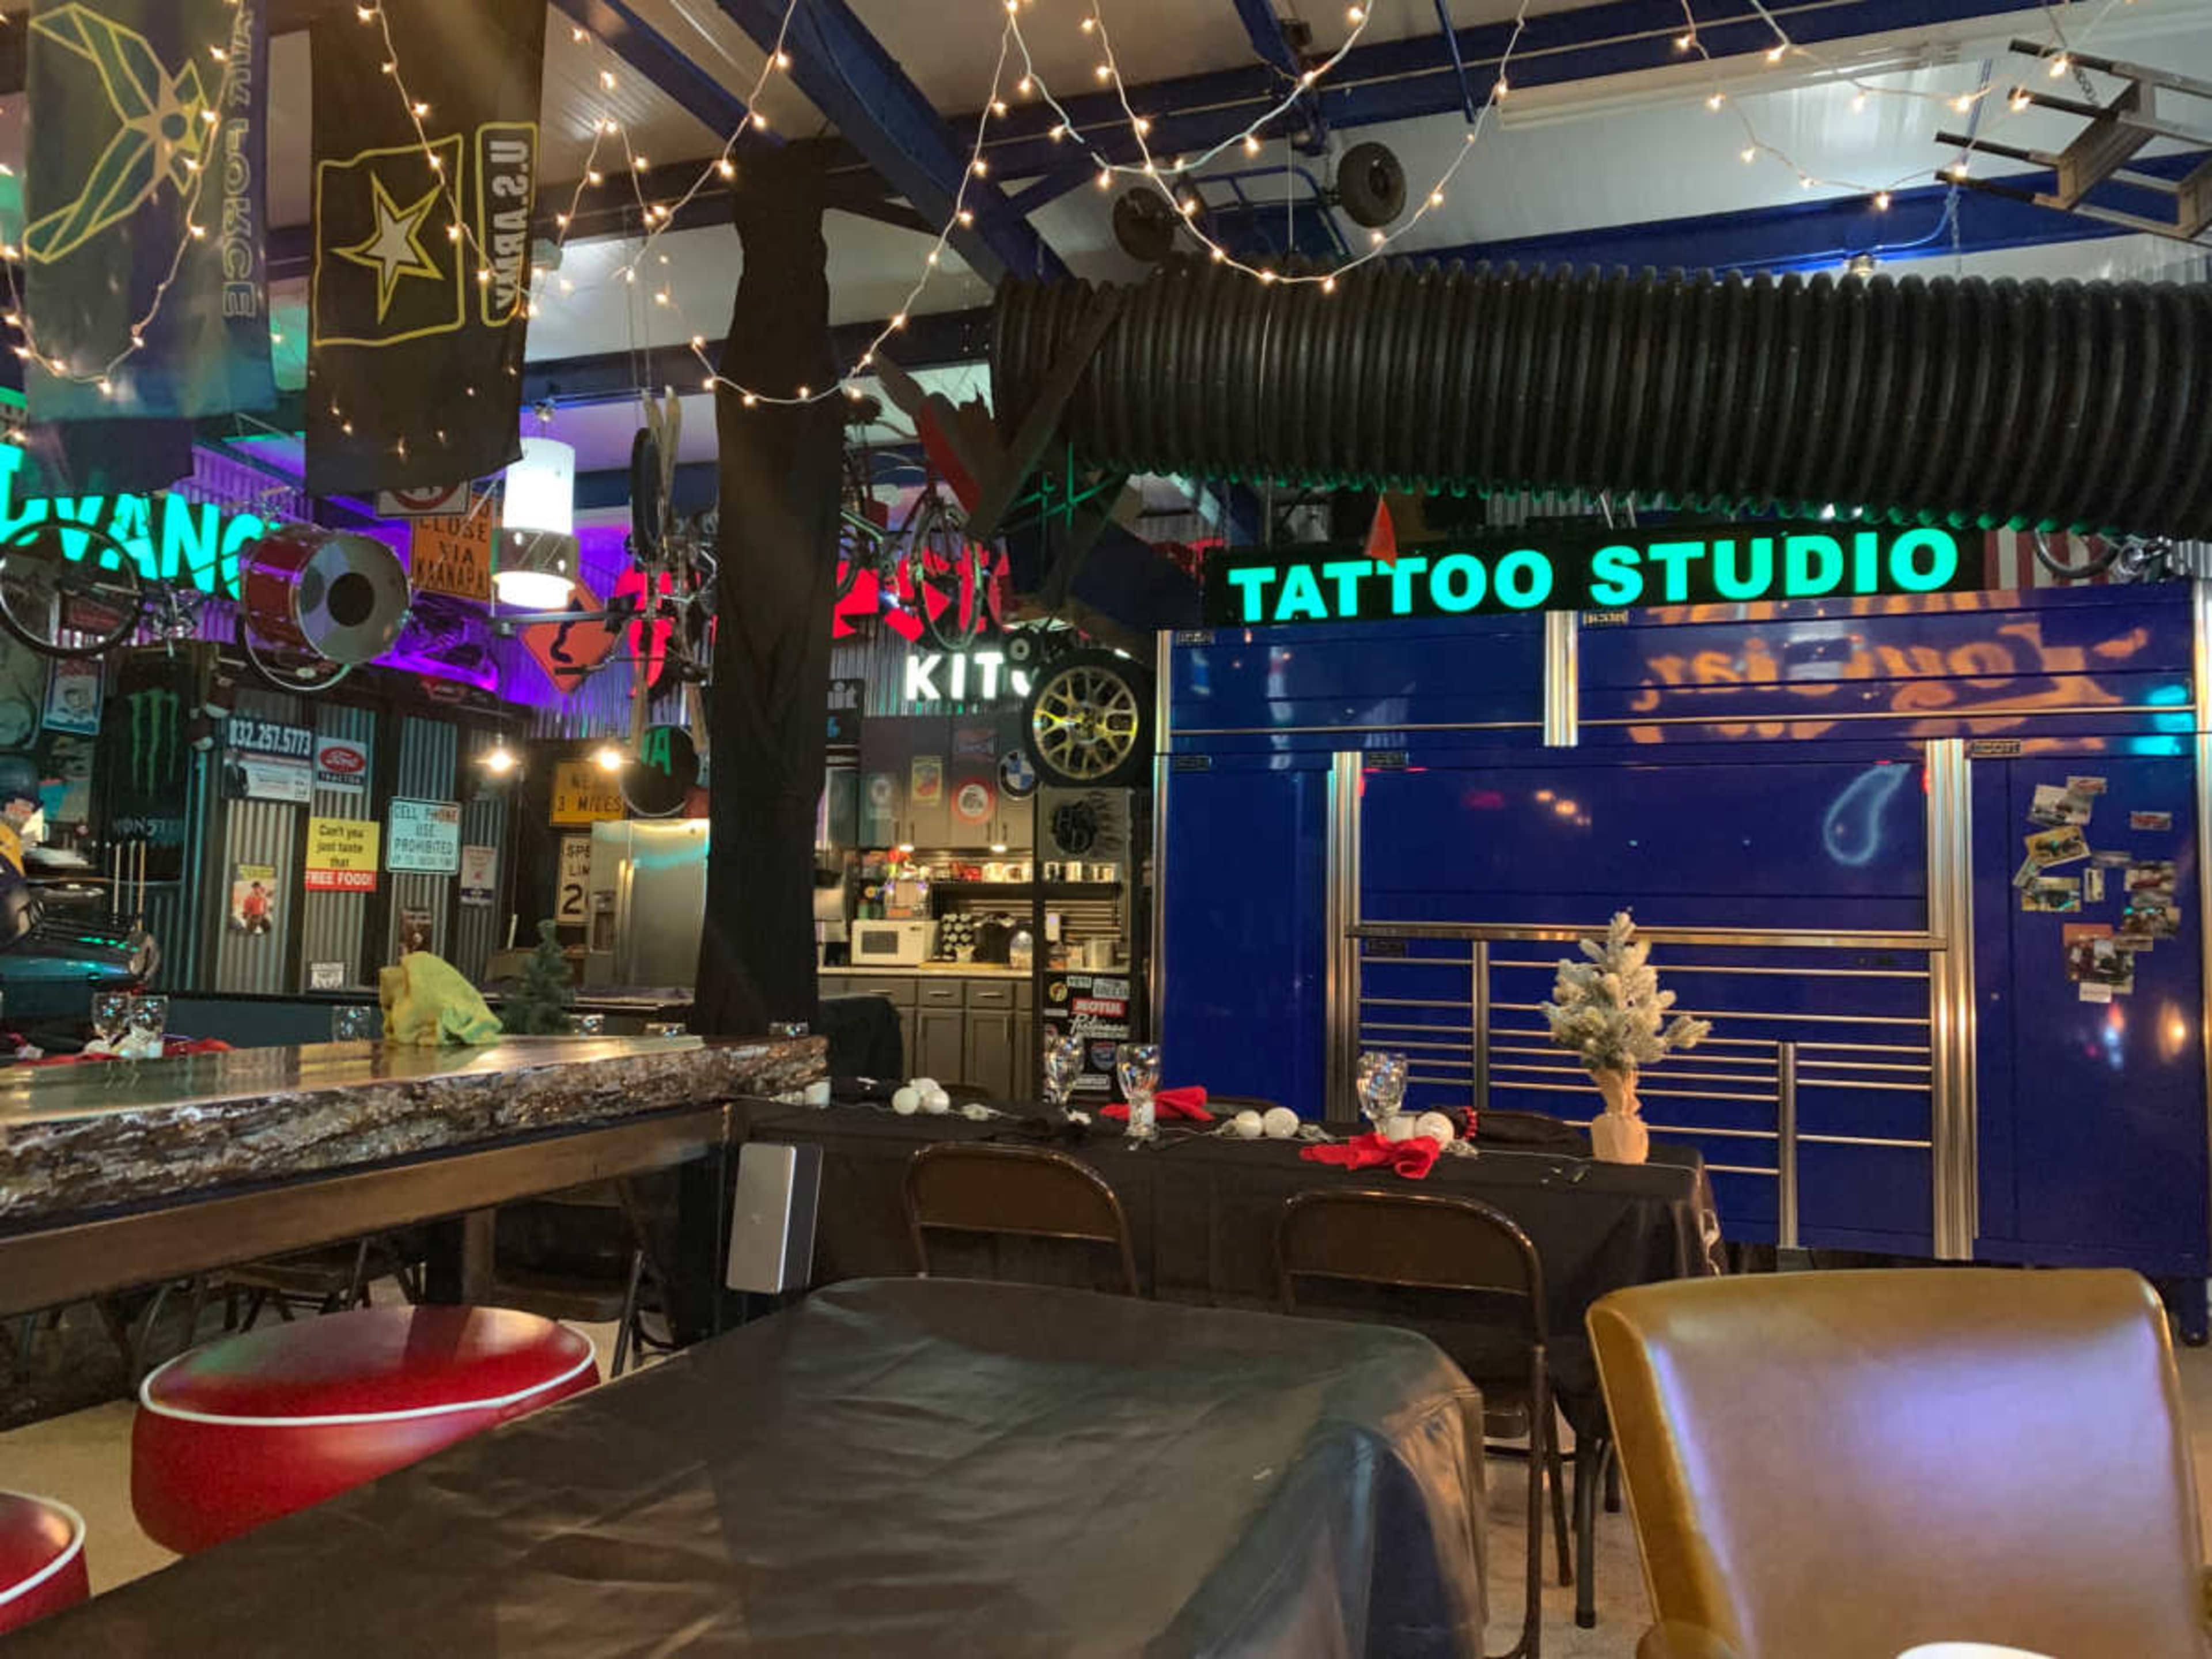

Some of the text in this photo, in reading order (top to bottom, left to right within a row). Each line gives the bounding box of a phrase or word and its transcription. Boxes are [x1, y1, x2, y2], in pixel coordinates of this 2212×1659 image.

[1228, 528, 1958, 623] TATTOO STUDIO
[578, 795, 623, 813] MILES
[347, 828, 364, 841] you
[394, 838, 454, 856] PROHIBITED
[567, 844, 590, 858] SPE
[306, 871, 334, 885] FREE
[568, 864, 590, 877] LIM
[562, 884, 590, 915] 2
